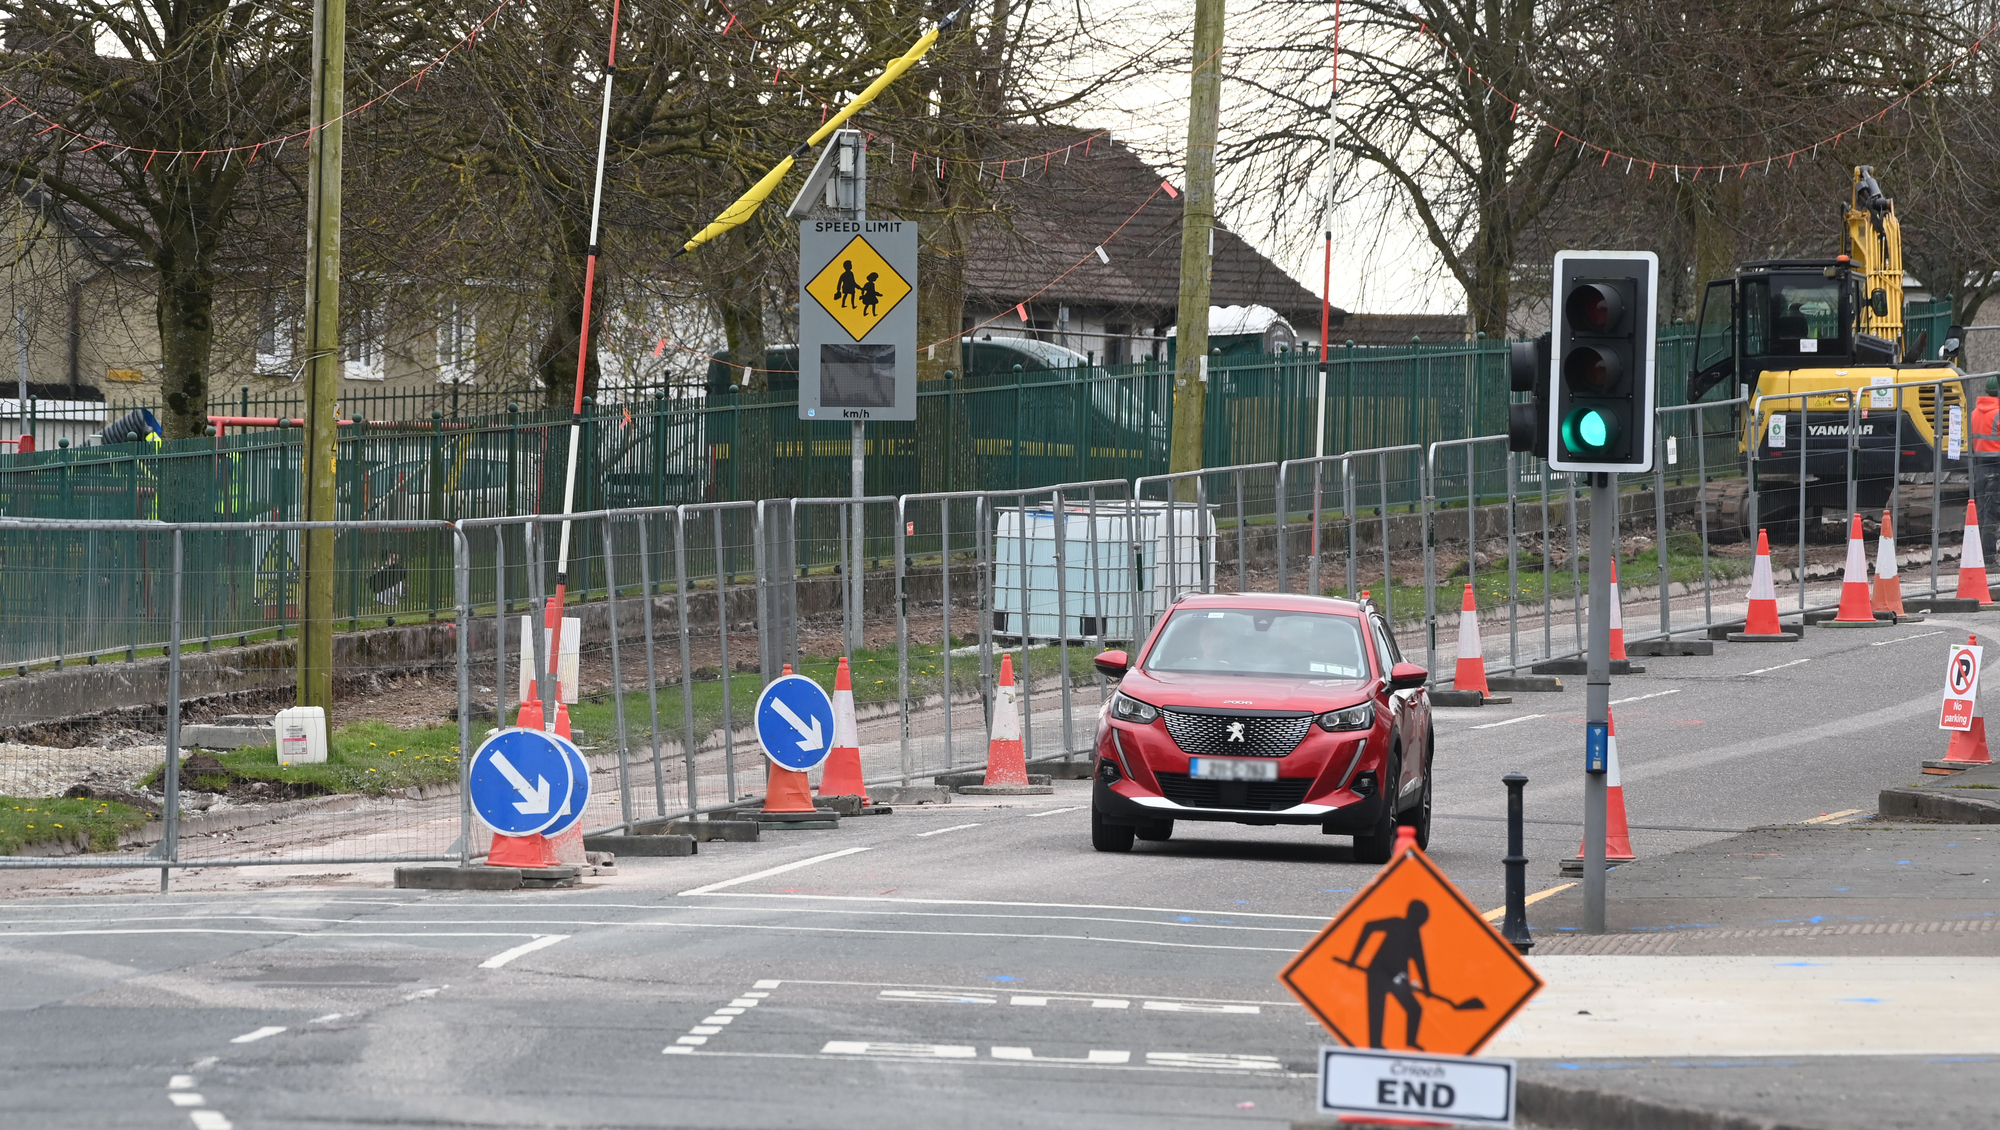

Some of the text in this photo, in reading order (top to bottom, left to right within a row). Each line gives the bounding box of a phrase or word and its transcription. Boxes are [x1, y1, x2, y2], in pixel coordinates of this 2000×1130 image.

[815, 222, 902, 233] SPEED LIMIT
[843, 408, 870, 418] km/h
[1956, 659, 1970, 685] P
[1953, 701, 1962, 711] No
[1944, 713, 1968, 725] parking
[1377, 1079, 1456, 1109] END
